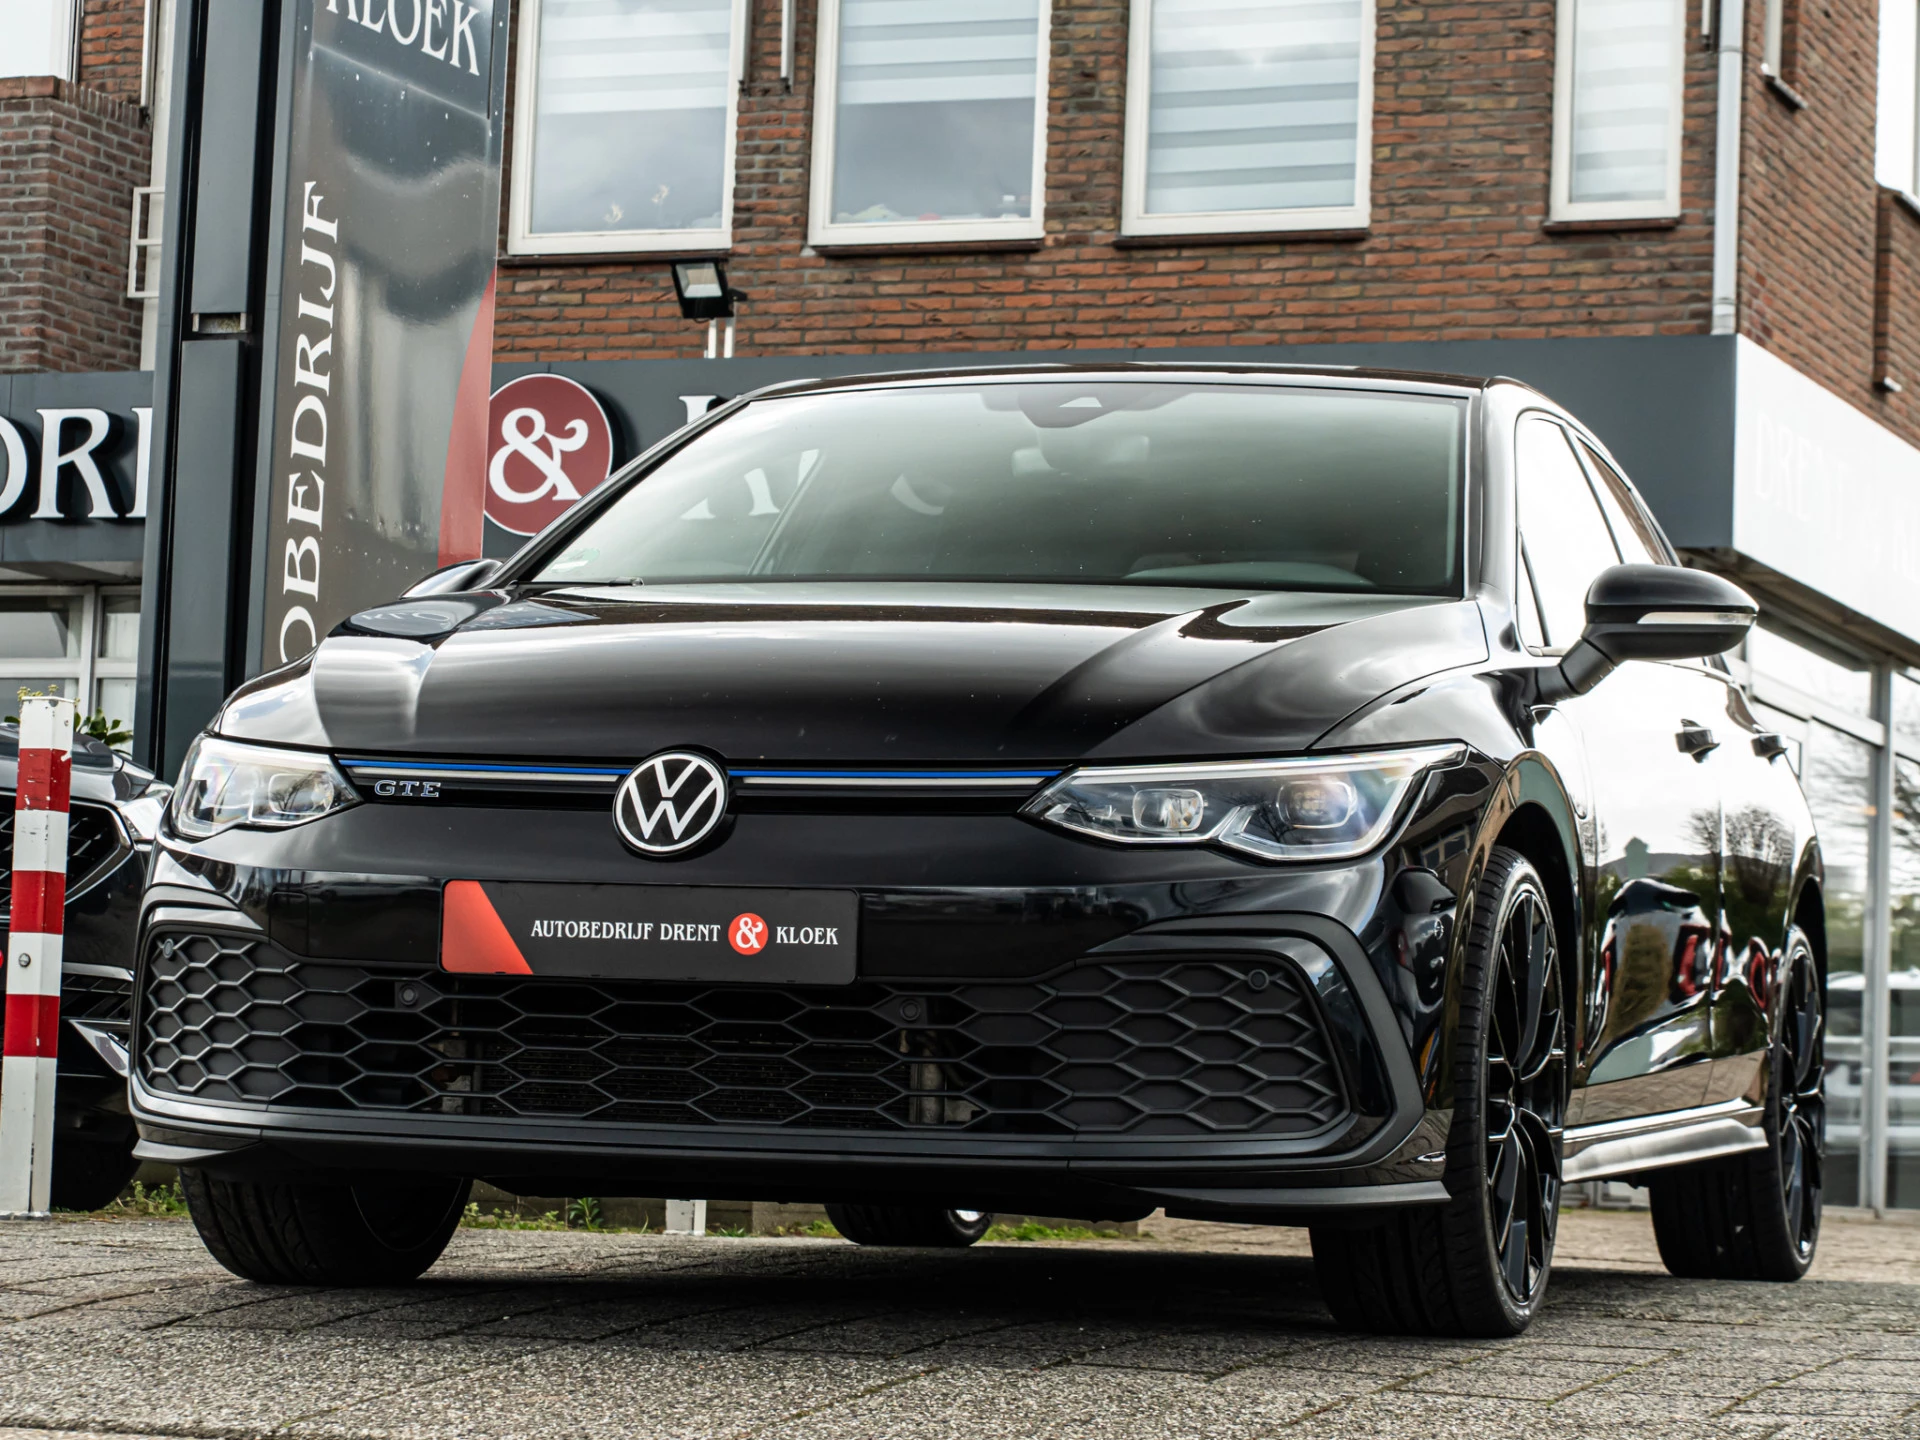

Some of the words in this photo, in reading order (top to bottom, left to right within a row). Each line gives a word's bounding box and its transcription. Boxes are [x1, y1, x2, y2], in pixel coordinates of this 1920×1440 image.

[489, 407, 588, 503] &
[374, 779, 442, 798] GTE
[531, 919, 654, 941] AUTOBEDRIJF
[659, 922, 721, 942] DRENT
[735, 916, 764, 949] &
[775, 926, 839, 945] KLOEK
